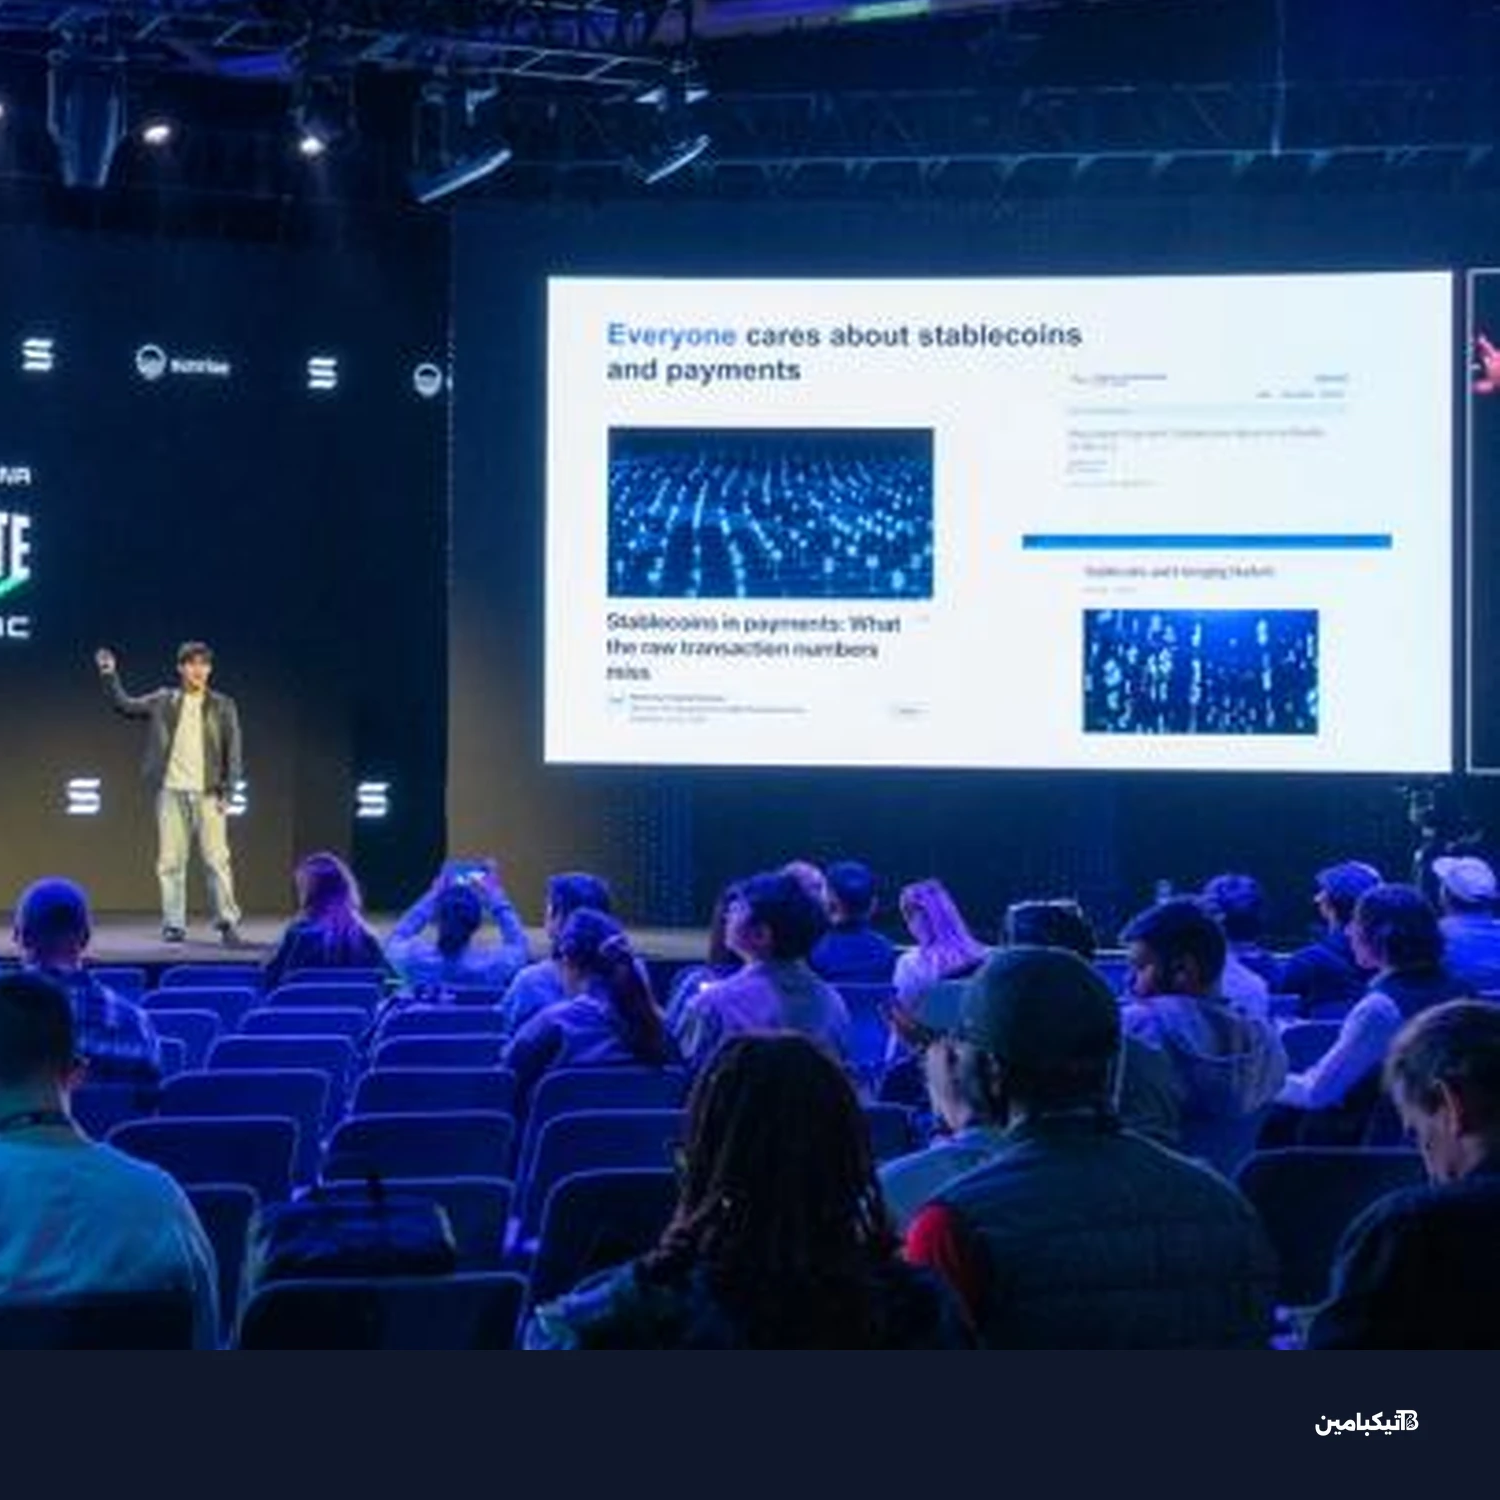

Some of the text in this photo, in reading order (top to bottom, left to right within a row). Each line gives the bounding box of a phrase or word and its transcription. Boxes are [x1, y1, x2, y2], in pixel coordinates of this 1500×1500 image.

[607, 322, 1083, 351] Everyone cares about stablecoins
[607, 359, 802, 388] and payments
[606, 612, 901, 634] Stablecoins in payments: What
[607, 639, 879, 660] the raw transaction numbers
